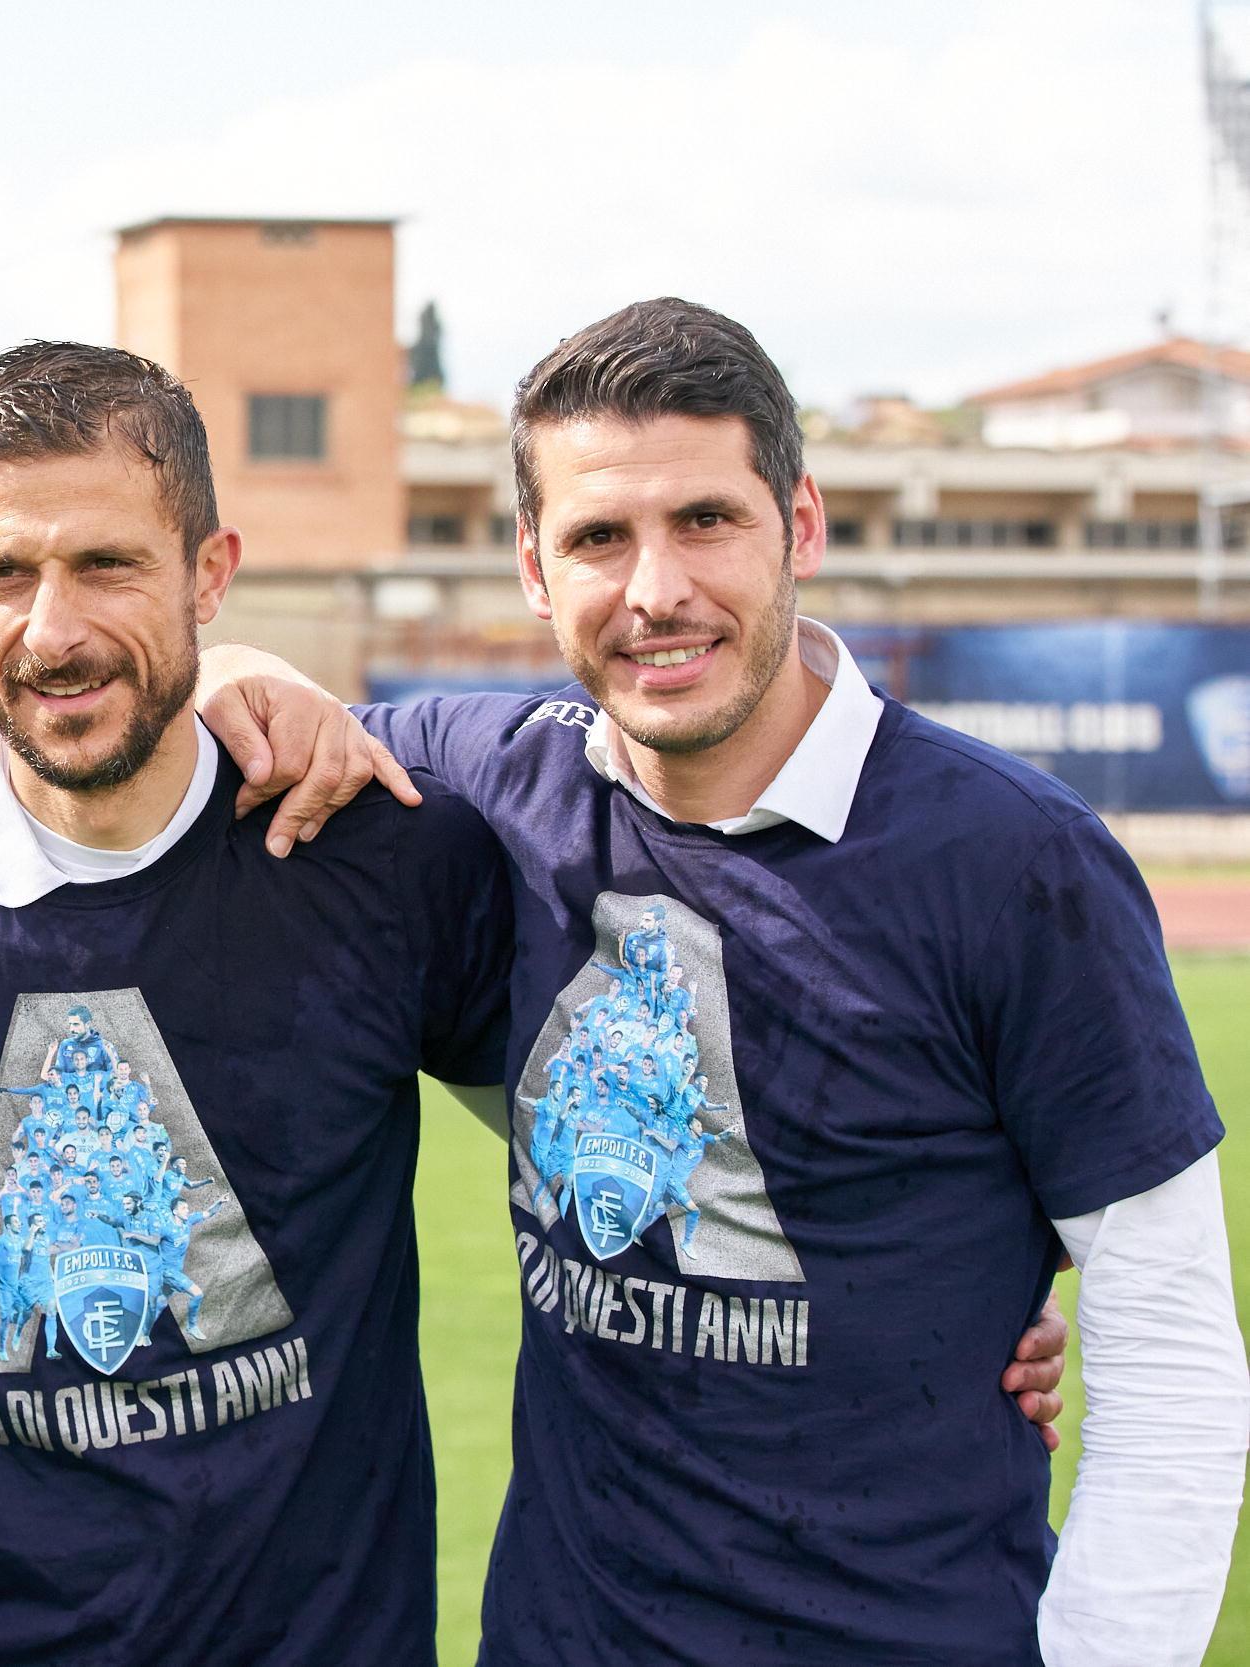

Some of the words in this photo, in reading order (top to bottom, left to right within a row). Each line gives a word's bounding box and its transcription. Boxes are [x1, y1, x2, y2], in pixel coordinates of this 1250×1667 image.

[584, 1138, 628, 1159] EMPOLI
[628, 1145, 648, 1170] F.C.
[64, 1251, 110, 1275] EMPOLI
[113, 1251, 138, 1271] F.C.
[562, 1258, 687, 1354] QUESTI
[693, 1291, 810, 1367] ANNI
[5, 1389, 54, 1452] DI
[55, 1367, 207, 1460] QUESTI
[211, 1337, 313, 1427] ANNI
